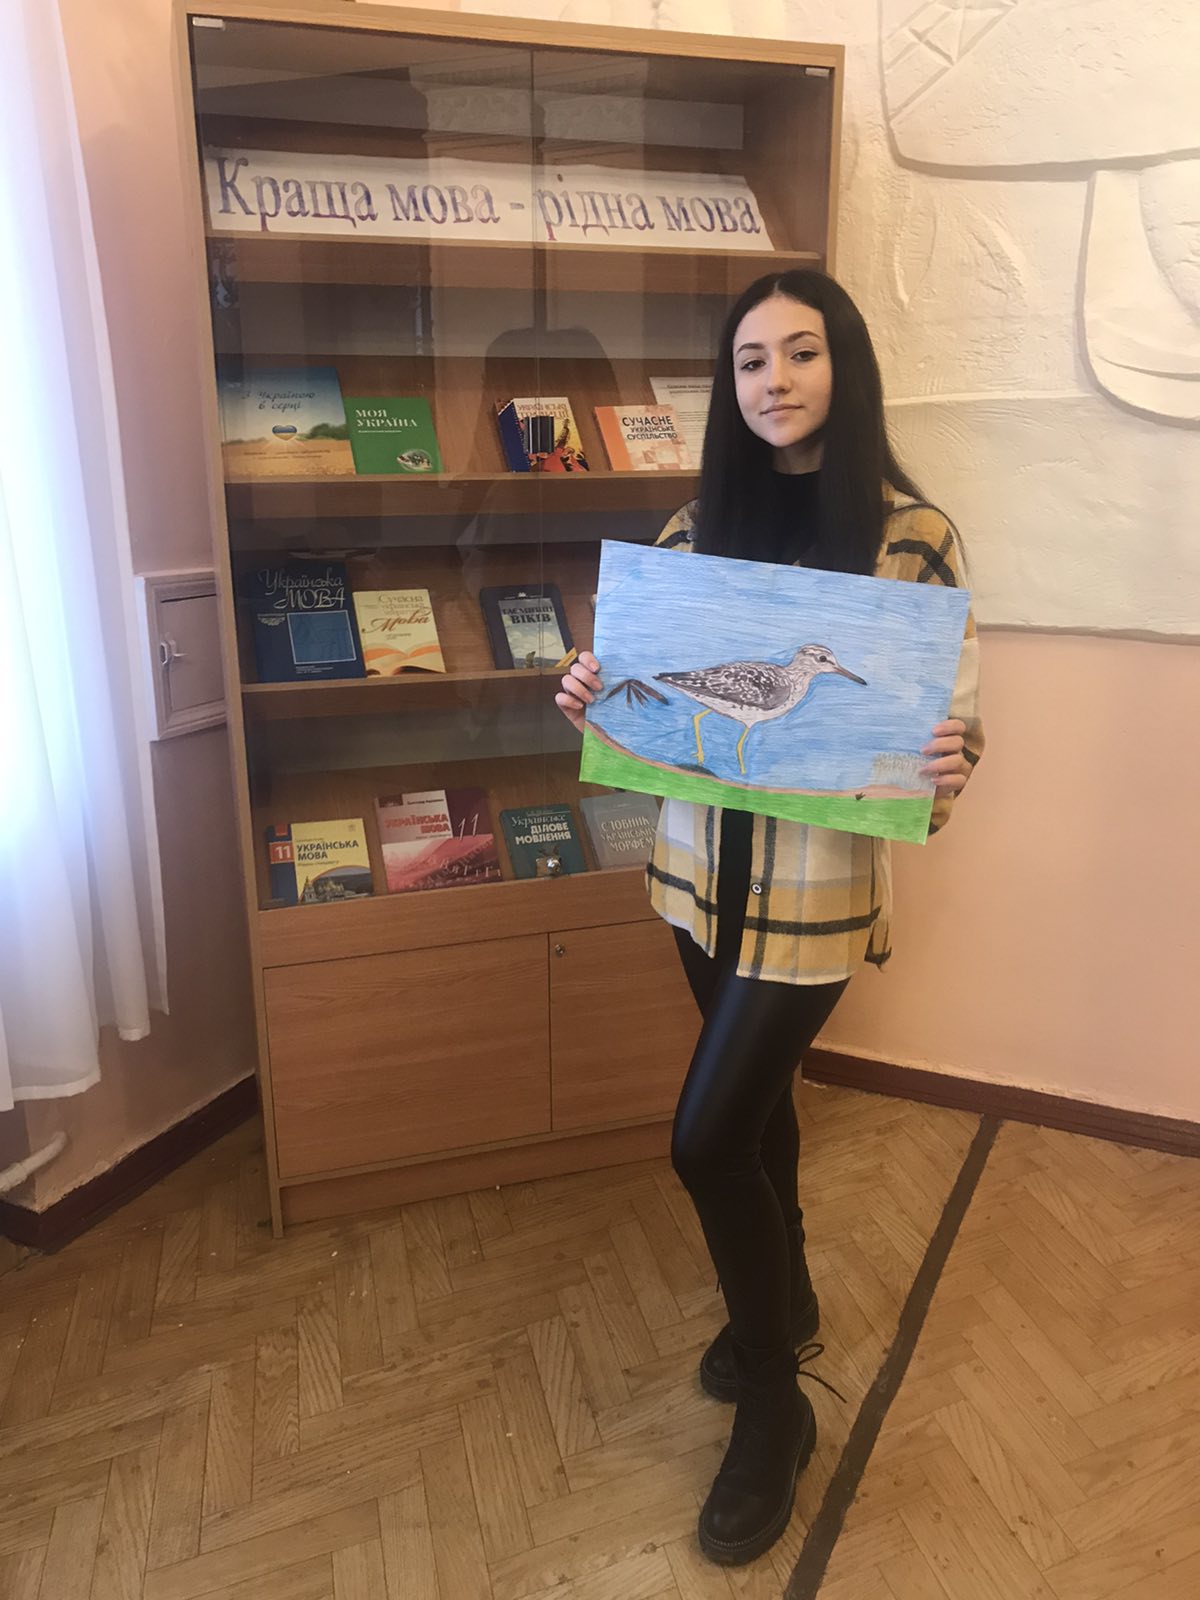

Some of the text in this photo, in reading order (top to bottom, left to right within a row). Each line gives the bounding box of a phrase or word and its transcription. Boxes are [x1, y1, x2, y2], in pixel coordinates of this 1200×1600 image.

[217, 157, 378, 232] Краща
[385, 184, 500, 225] мова
[533, 174, 655, 241] рідна
[656, 194, 761, 234] мова
[355, 409, 388, 417] МОЯ
[356, 417, 418, 427] УКРАЇНА
[622, 415, 673, 427] СУЧАСНЕ
[629, 425, 676, 433] УКРАЇНСЬКЕ
[626, 432, 678, 440] СУСПІЛЬСТВО
[258, 567, 344, 596] Українська
[273, 587, 346, 610] МОВА
[510, 613, 552, 625] ВІКІВ
[530, 822, 570, 835] ДІЛОВЕ
[515, 831, 572, 846] МОВЛЕННЯ
[297, 839, 360, 853] УКРАЇНСЬКА
[275, 845, 292, 860] 11
[297, 851, 329, 861] МОВА
